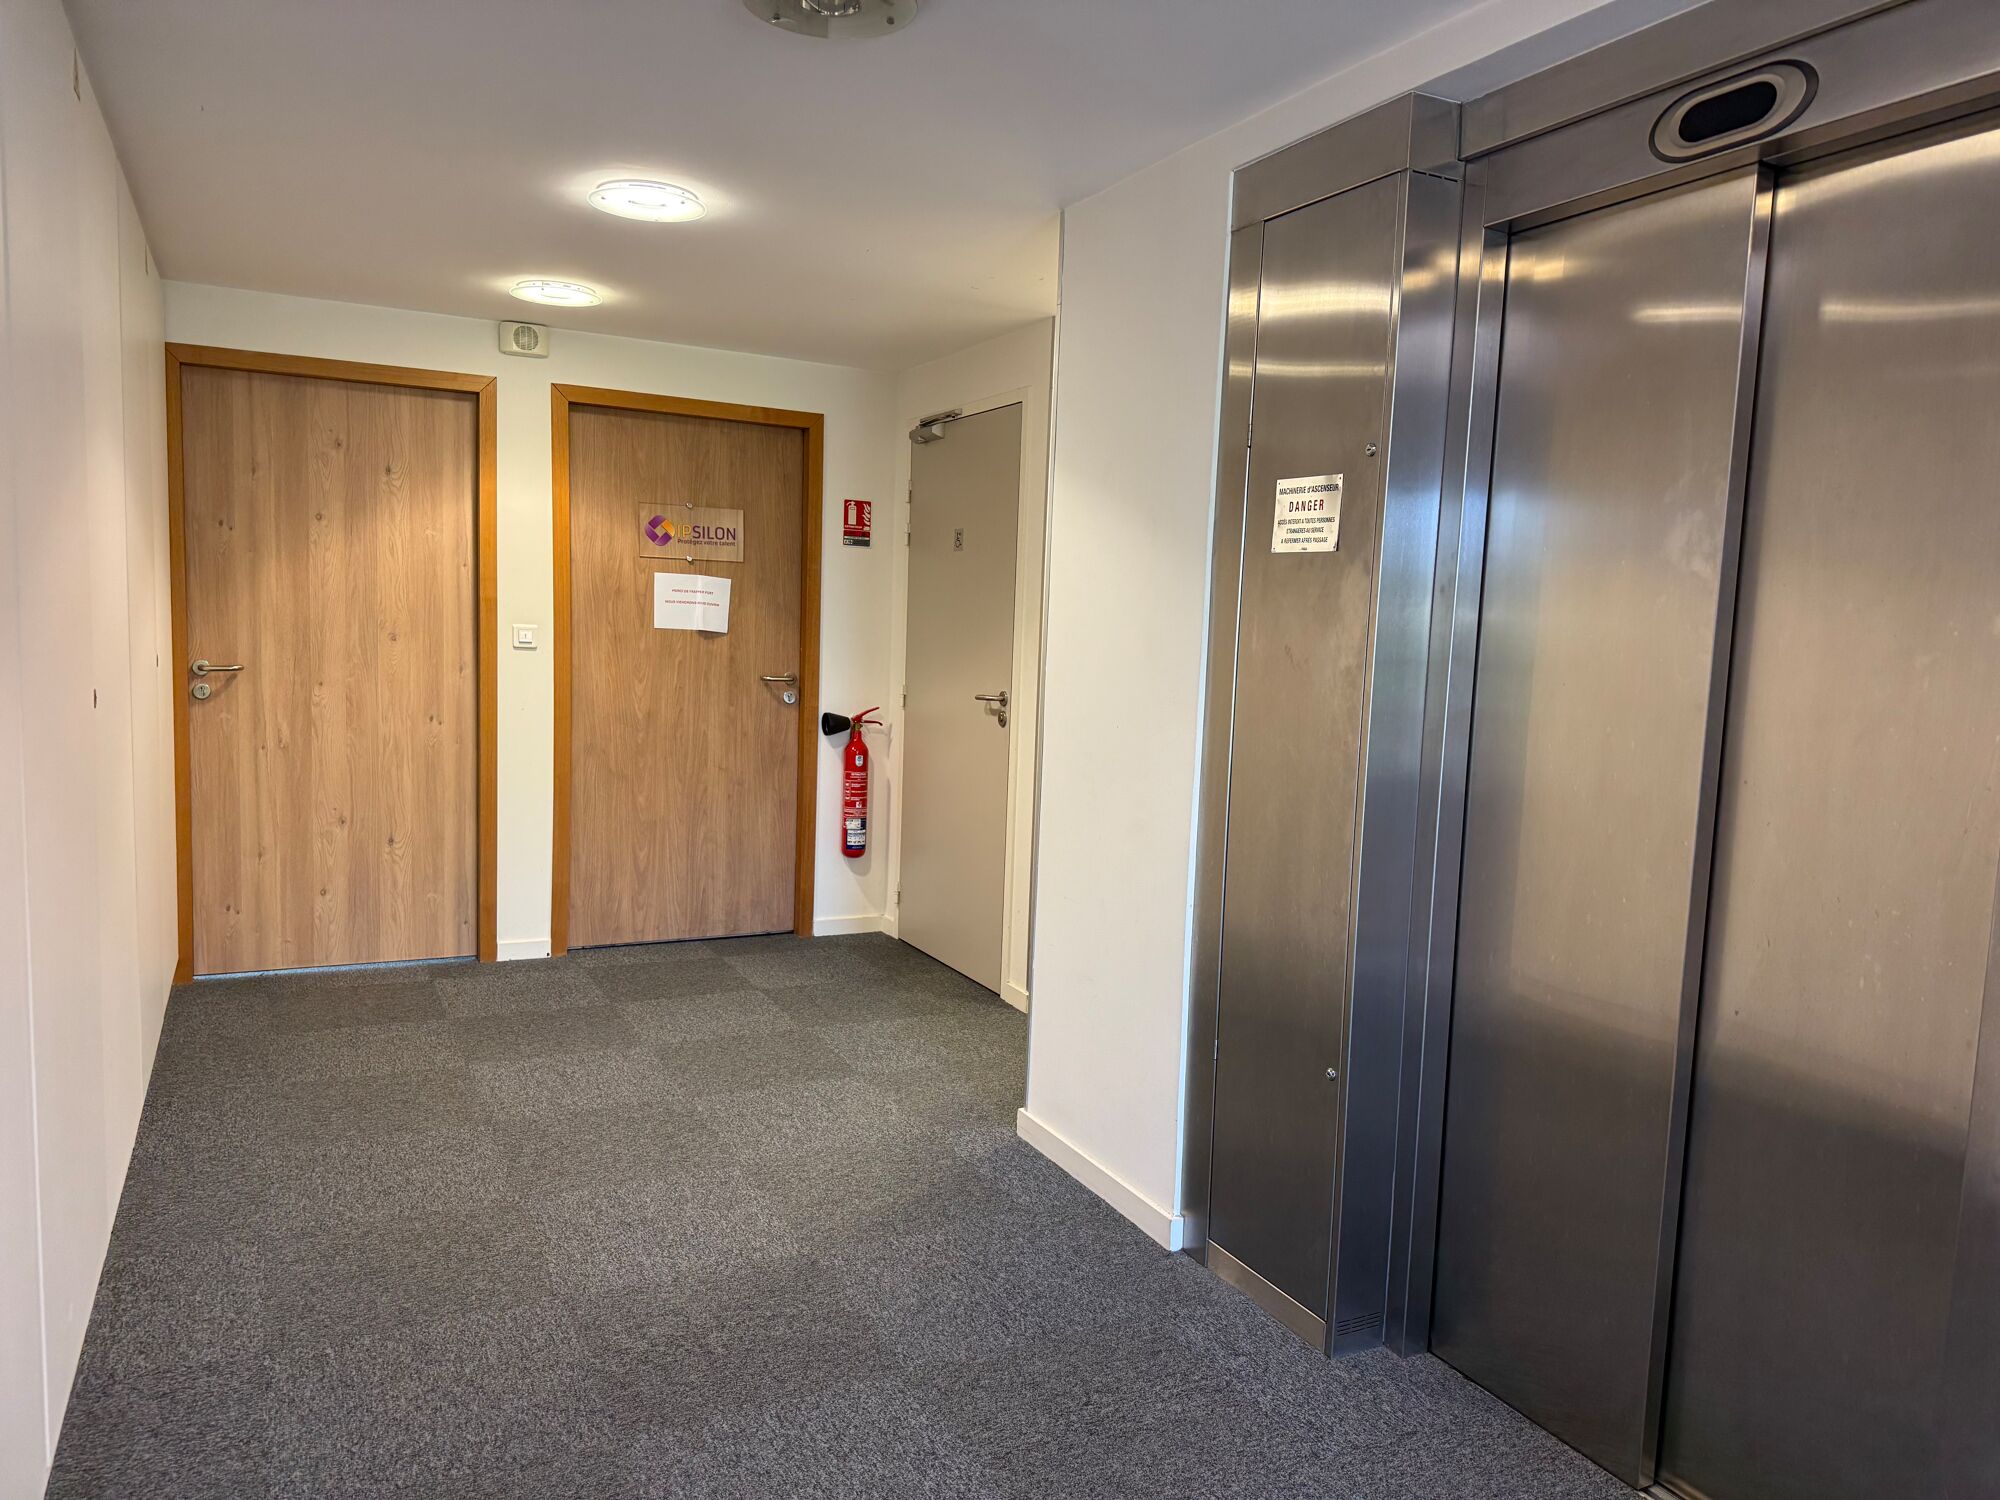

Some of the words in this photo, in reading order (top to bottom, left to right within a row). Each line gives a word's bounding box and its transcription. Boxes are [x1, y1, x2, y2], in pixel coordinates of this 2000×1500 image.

[1279, 486, 1306, 495] MACHINERIE
[1307, 483, 1339, 493] d'ASCENSEUR
[1289, 499, 1324, 512] DANGER
[1317, 516, 1335, 524] PERSONNES
[677, 524, 736, 541] IPSILON
